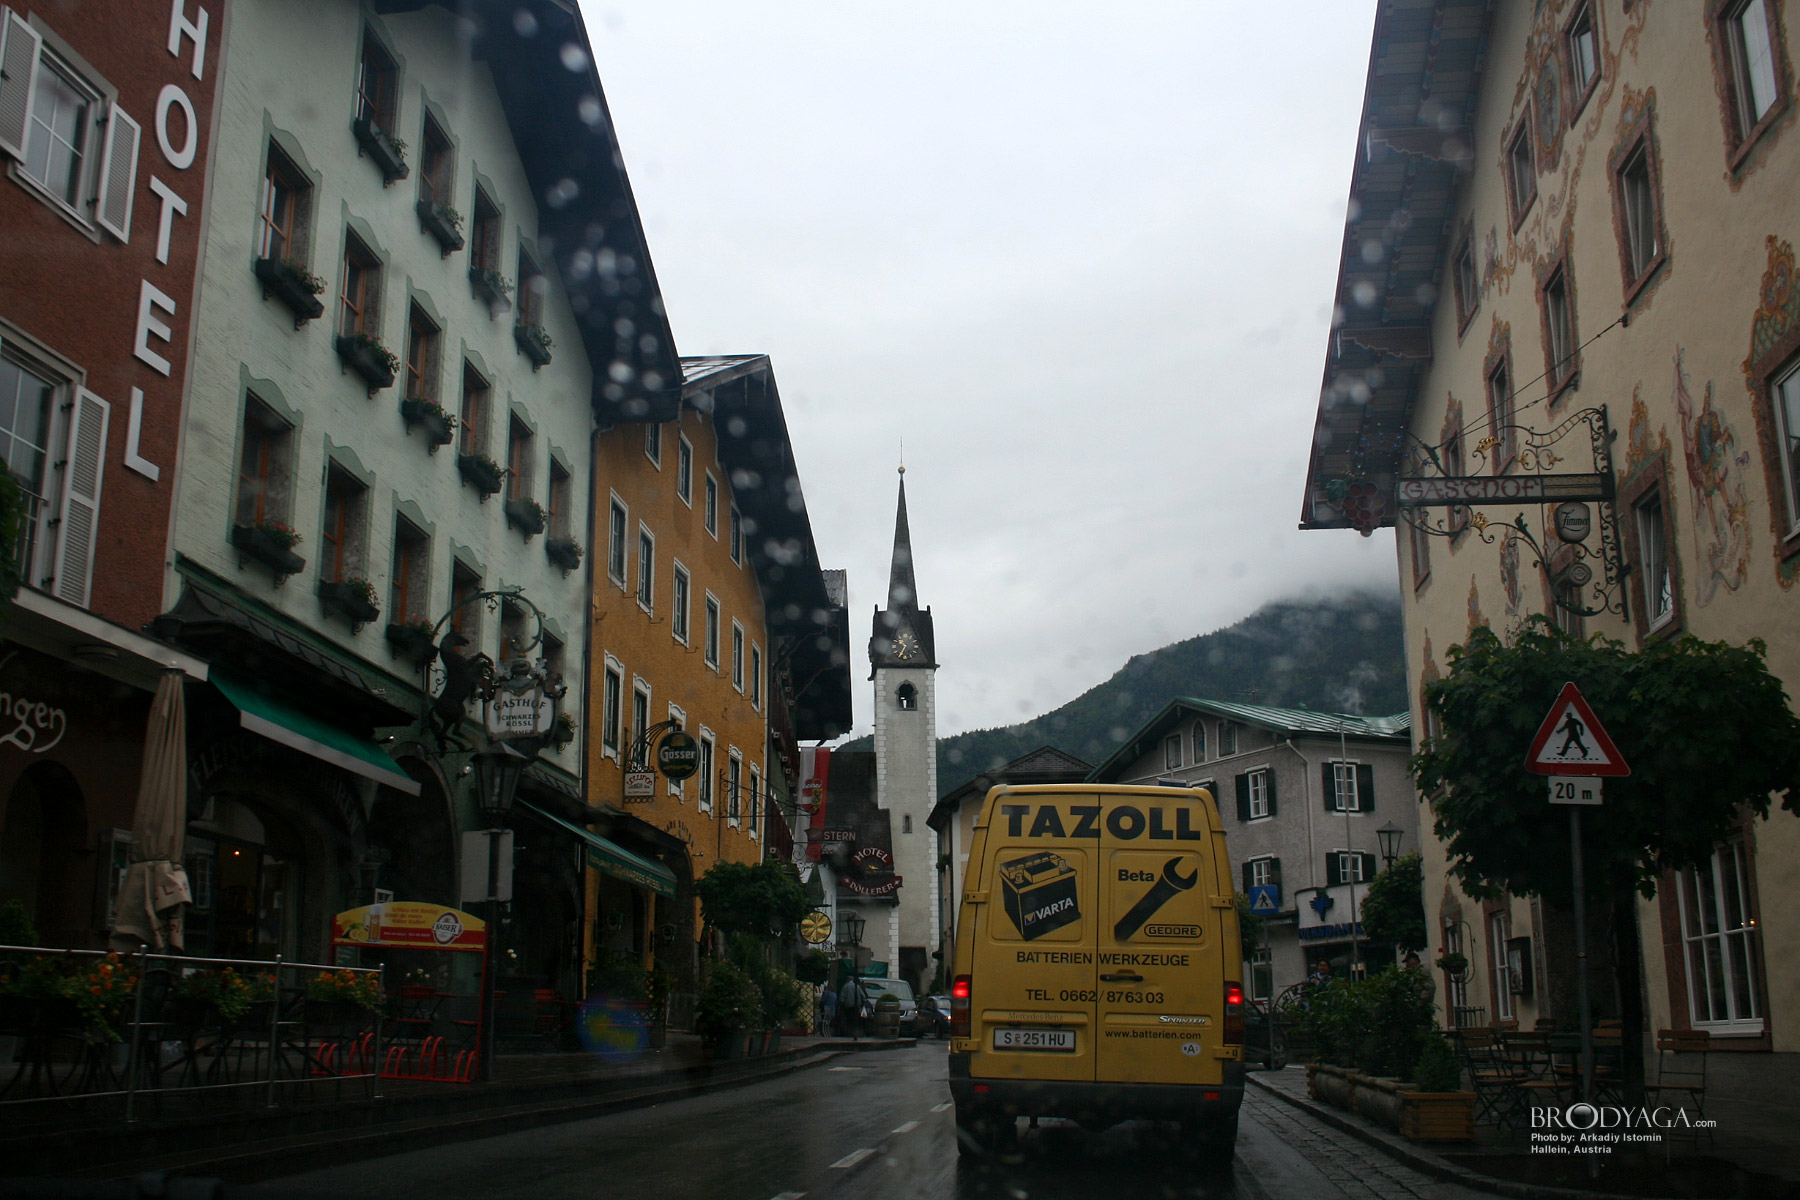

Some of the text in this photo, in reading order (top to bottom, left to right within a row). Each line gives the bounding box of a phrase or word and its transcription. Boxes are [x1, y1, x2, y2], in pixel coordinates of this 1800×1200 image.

[123, 0, 209, 482] HOTEL
[1403, 478, 1539, 499] GASTHOF
[1561, 508, 1589, 530] Zimmer
[493, 698, 546, 711] GASTHOF
[660, 746, 696, 762] Gösser
[1555, 782, 1593, 800] 20 m
[1001, 804, 1201, 841] TAZOLL
[823, 831, 856, 841] STERN
[854, 847, 889, 863] HOTEL
[1118, 869, 1155, 882] Beta
[1035, 897, 1075, 920] VARTA
[435, 923, 458, 933] KAISER
[1148, 926, 1198, 936] GEDORE
[1016, 951, 1190, 966] BATTERIEN WERKZEUGE
[1025, 989, 1055, 1001] TEL.
[1004, 1032, 1013, 1045] S
[1105, 1029, 1202, 1040] www.batterien.com
[1186, 1044, 1196, 1054] A
